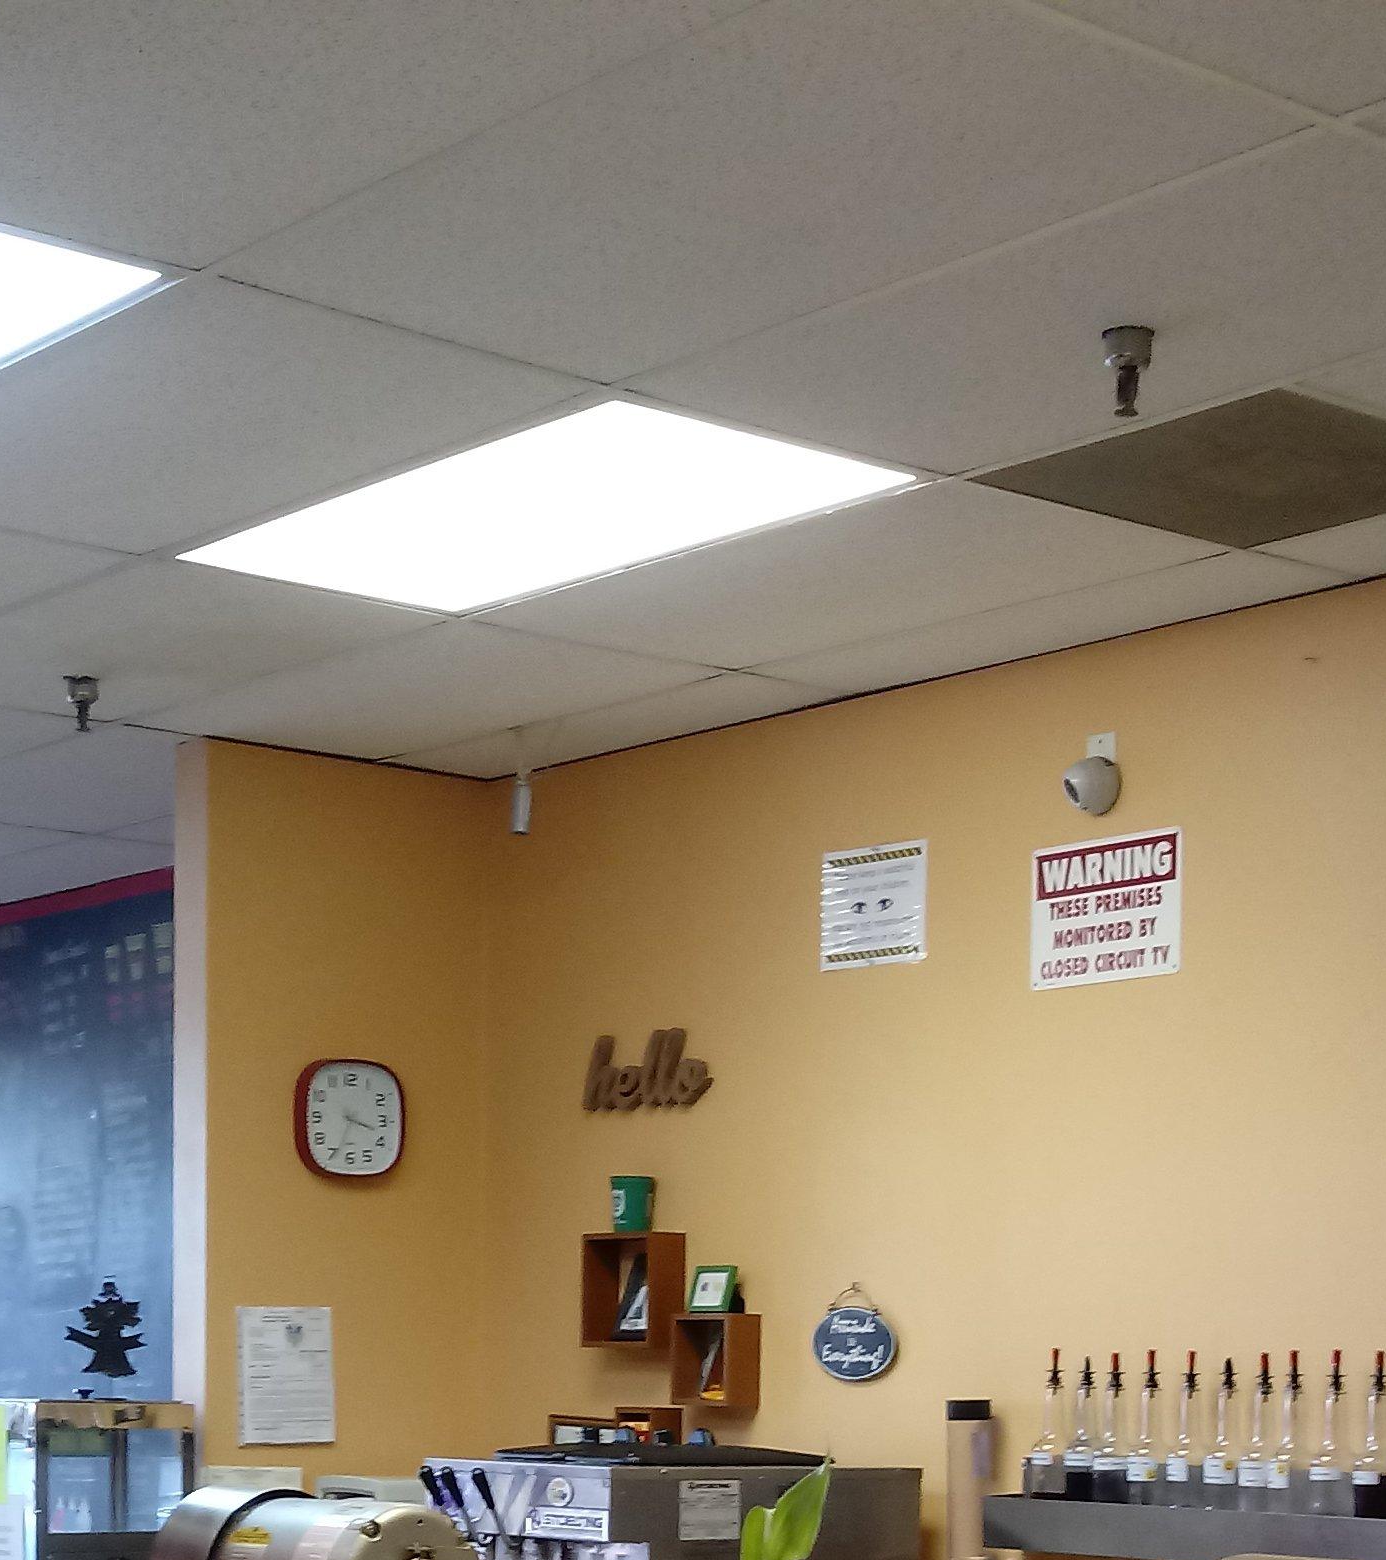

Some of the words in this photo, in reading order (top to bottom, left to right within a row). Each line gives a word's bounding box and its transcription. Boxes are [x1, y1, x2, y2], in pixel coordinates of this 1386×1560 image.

[1042, 841, 1174, 893] WARNING
[1049, 897, 1090, 921] THESE
[1095, 886, 1163, 914] PREMISES
[1052, 921, 1133, 950] MONITORED
[1138, 917, 1158, 938] BY
[1041, 956, 1089, 980] CLOSED
[1095, 948, 1146, 973] CIRCUIT
[1151, 945, 1170, 965] TV
[581, 1027, 714, 1113] hello
[344, 1073, 358, 1087] 12
[375, 1093, 386, 1107] 2
[377, 1114, 387, 1128] 3
[315, 1132, 325, 1145] 8
[375, 1135, 386, 1148] 4
[327, 1147, 339, 1161] 7
[345, 1151, 356, 1165] 6
[362, 1149, 373, 1163] 5
